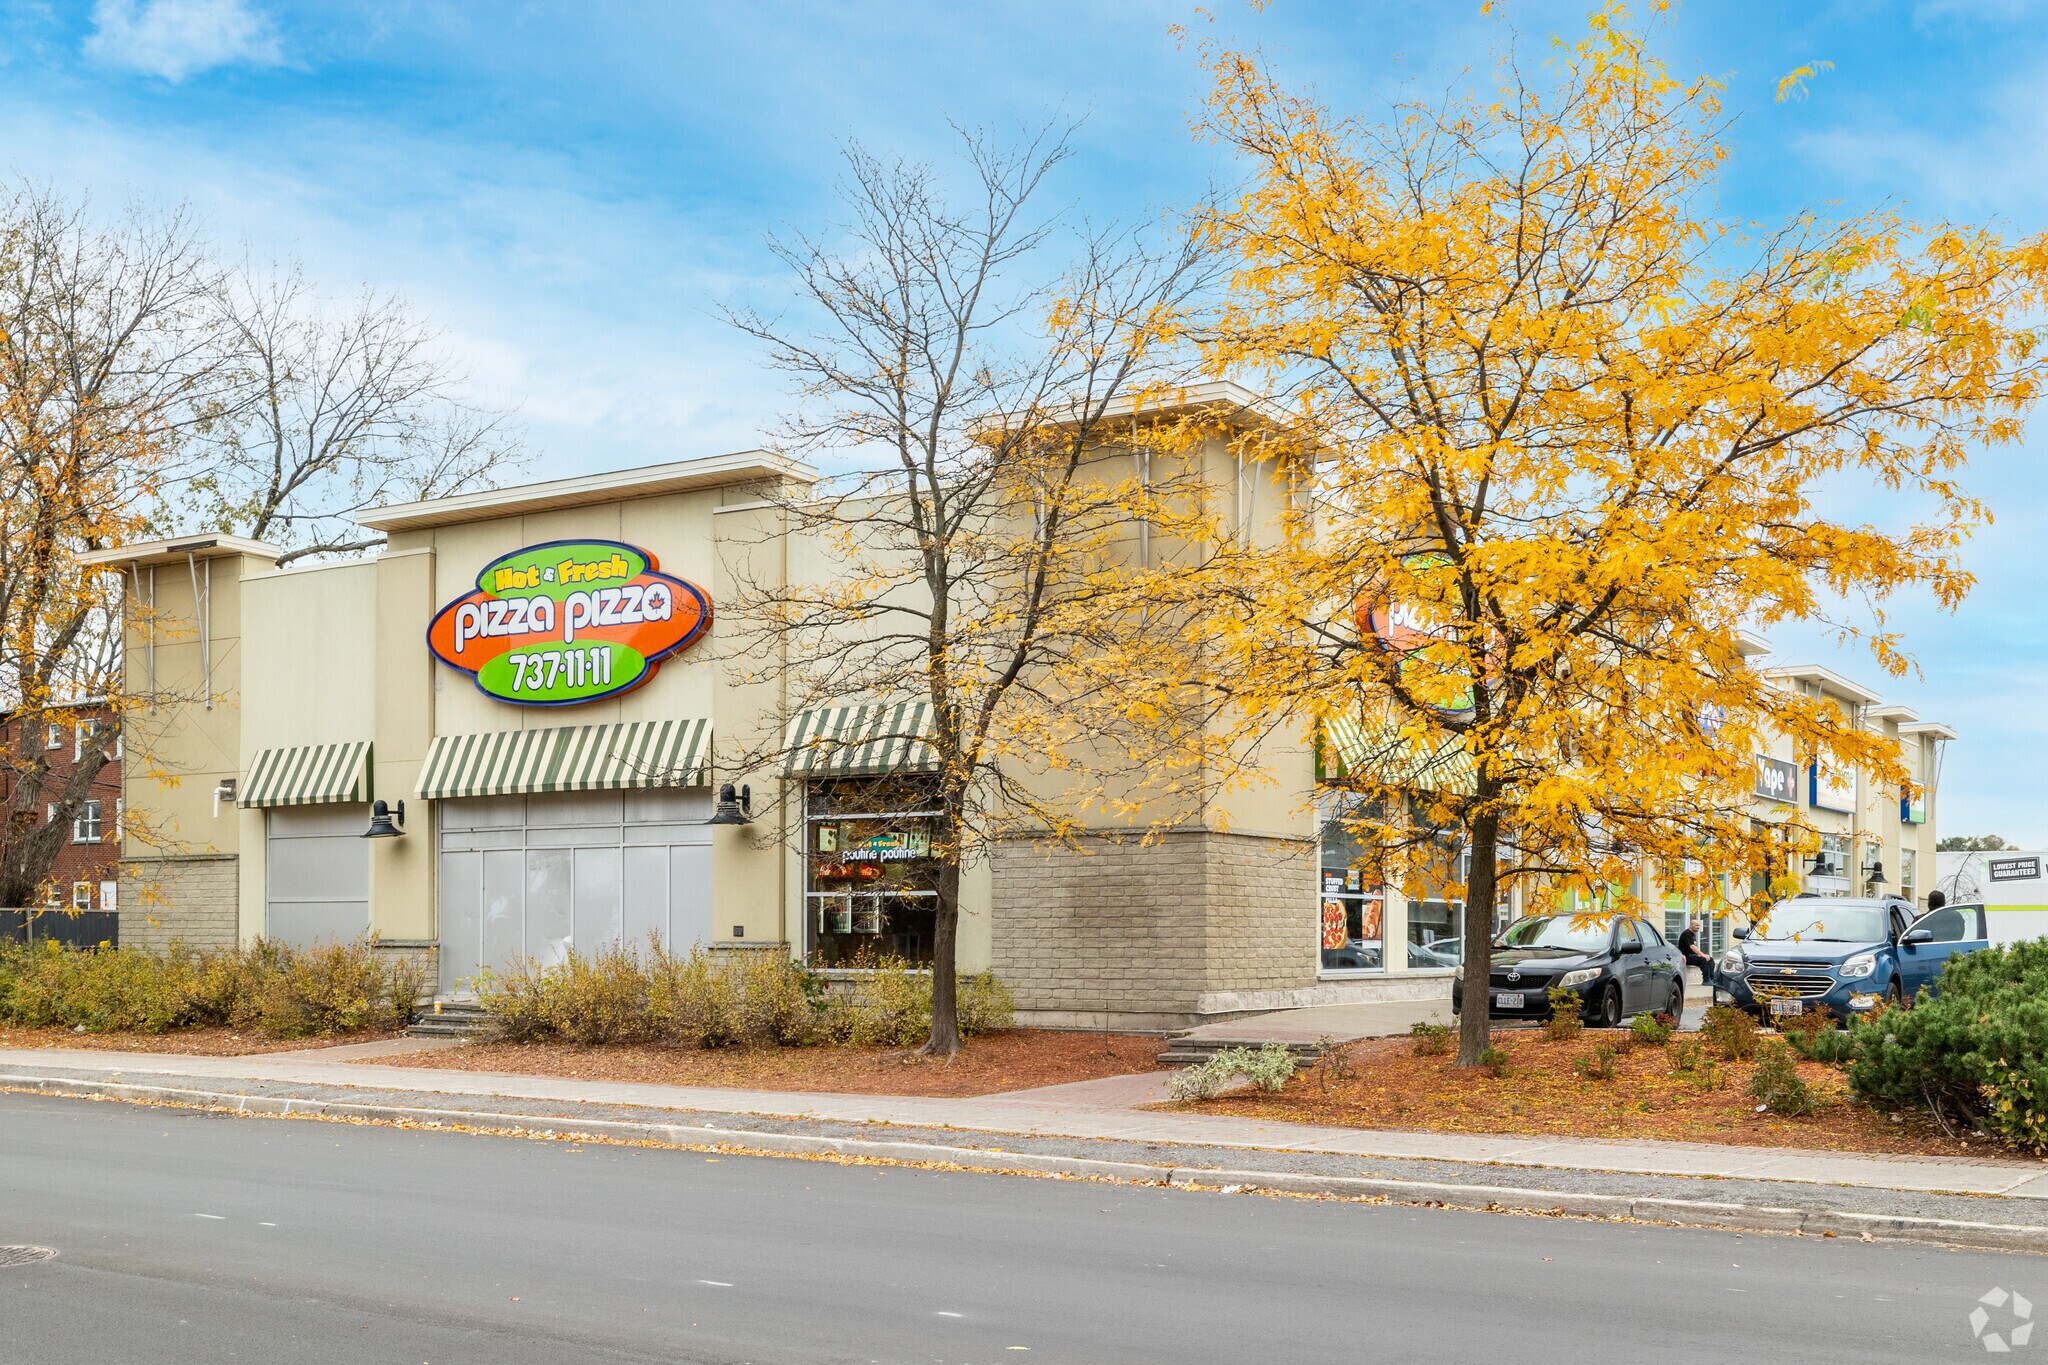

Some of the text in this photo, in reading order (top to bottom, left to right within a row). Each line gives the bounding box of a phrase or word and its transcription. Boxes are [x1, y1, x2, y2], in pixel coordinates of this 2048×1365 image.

[495, 553, 629, 592] Hot & Fresh
[1757, 757, 1785, 796] Vape
[880, 847, 916, 863] poutine
[1993, 868, 2036, 878] GUARANTEED
